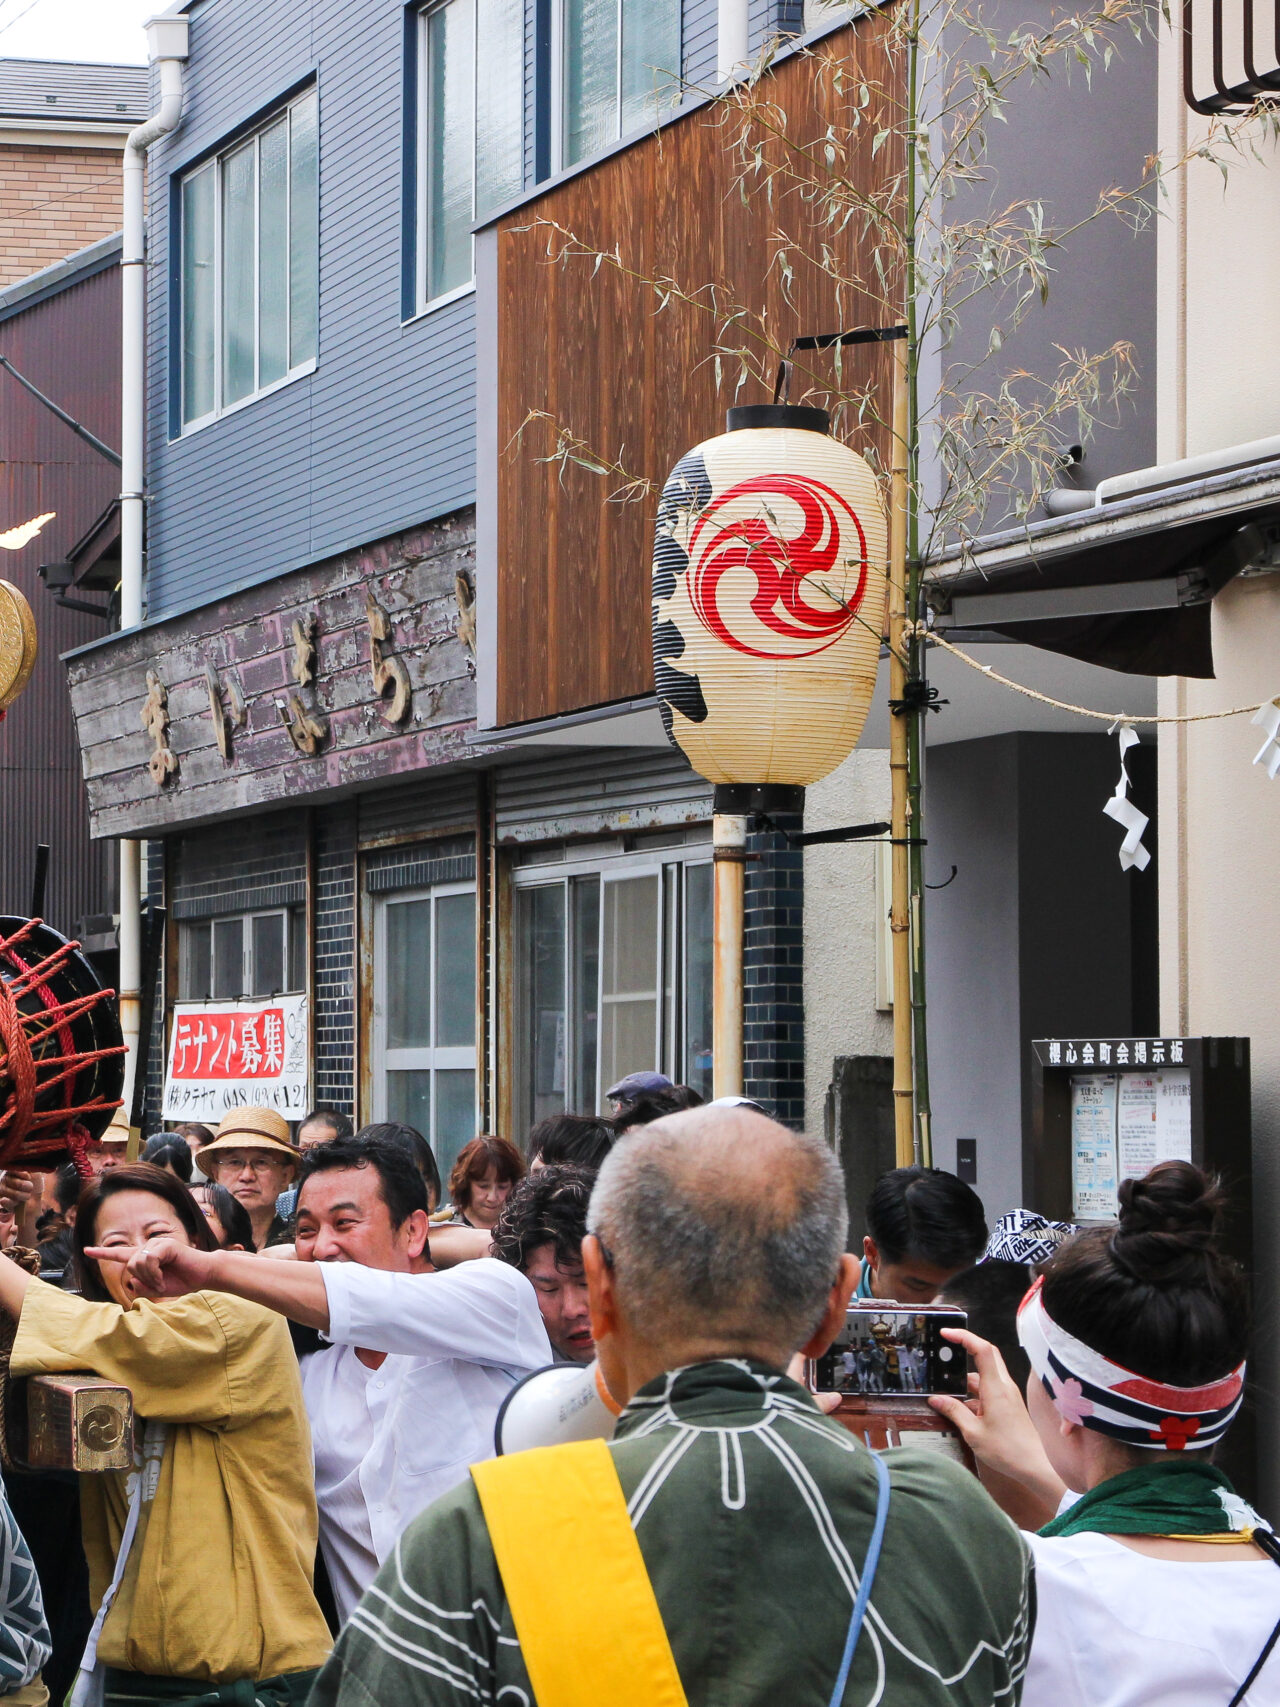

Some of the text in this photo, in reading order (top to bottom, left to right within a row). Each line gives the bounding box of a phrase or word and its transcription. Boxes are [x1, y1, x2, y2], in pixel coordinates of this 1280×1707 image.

[177, 1013, 283, 1074] テナント募集
